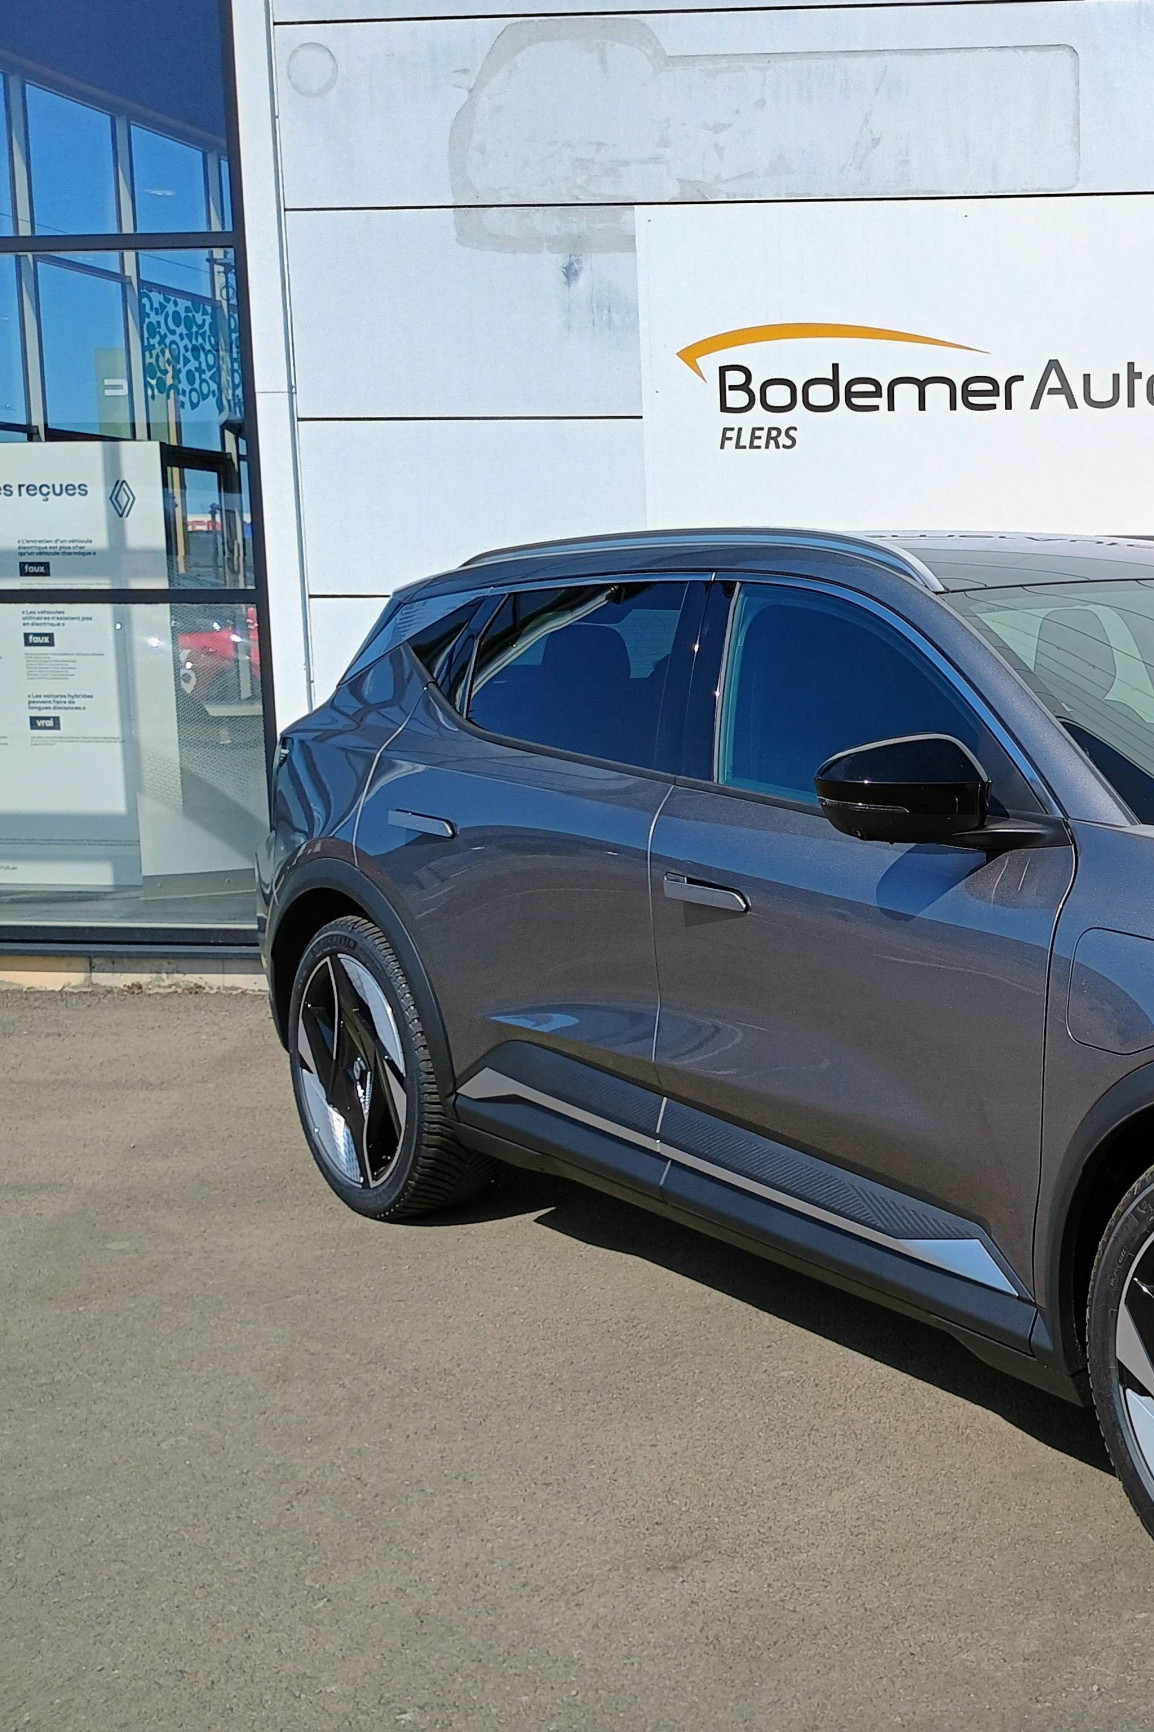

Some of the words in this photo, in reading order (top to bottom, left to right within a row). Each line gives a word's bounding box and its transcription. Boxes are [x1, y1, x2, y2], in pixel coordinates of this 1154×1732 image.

[719, 426, 798, 450] FLERS
[17, 483, 89, 502] reçues
[24, 564, 46, 573] faux
[28, 634, 50, 643] faux
[35, 717, 54, 727] vrai
